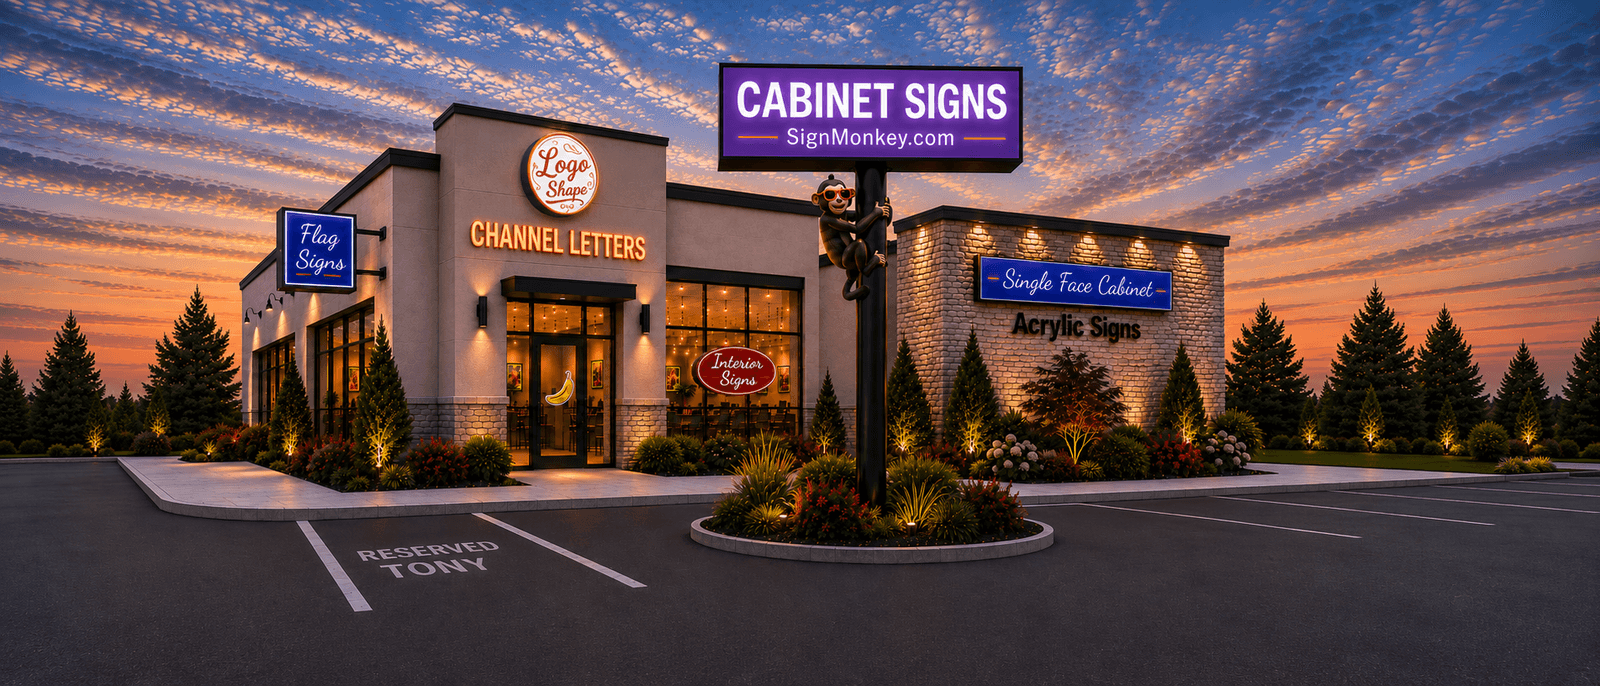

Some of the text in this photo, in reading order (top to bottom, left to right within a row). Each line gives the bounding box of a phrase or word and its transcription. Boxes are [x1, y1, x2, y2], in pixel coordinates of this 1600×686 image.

[736, 80, 1007, 120] CABINET SIGNS
[786, 127, 954, 149] SignMonkey.com
[535, 146, 592, 182] Logo
[545, 180, 588, 203] Shape
[300, 222, 341, 252] Flag
[470, 219, 646, 261] CHANNEL LETTERS
[295, 248, 347, 276] Signs
[1002, 267, 1154, 298] Single Face Cabinet
[1012, 312, 1142, 343] Acrylic Signs
[711, 352, 764, 370] Interior
[719, 369, 758, 391] Signs
[356, 541, 500, 562] RESERVED
[379, 557, 488, 579] TONY
